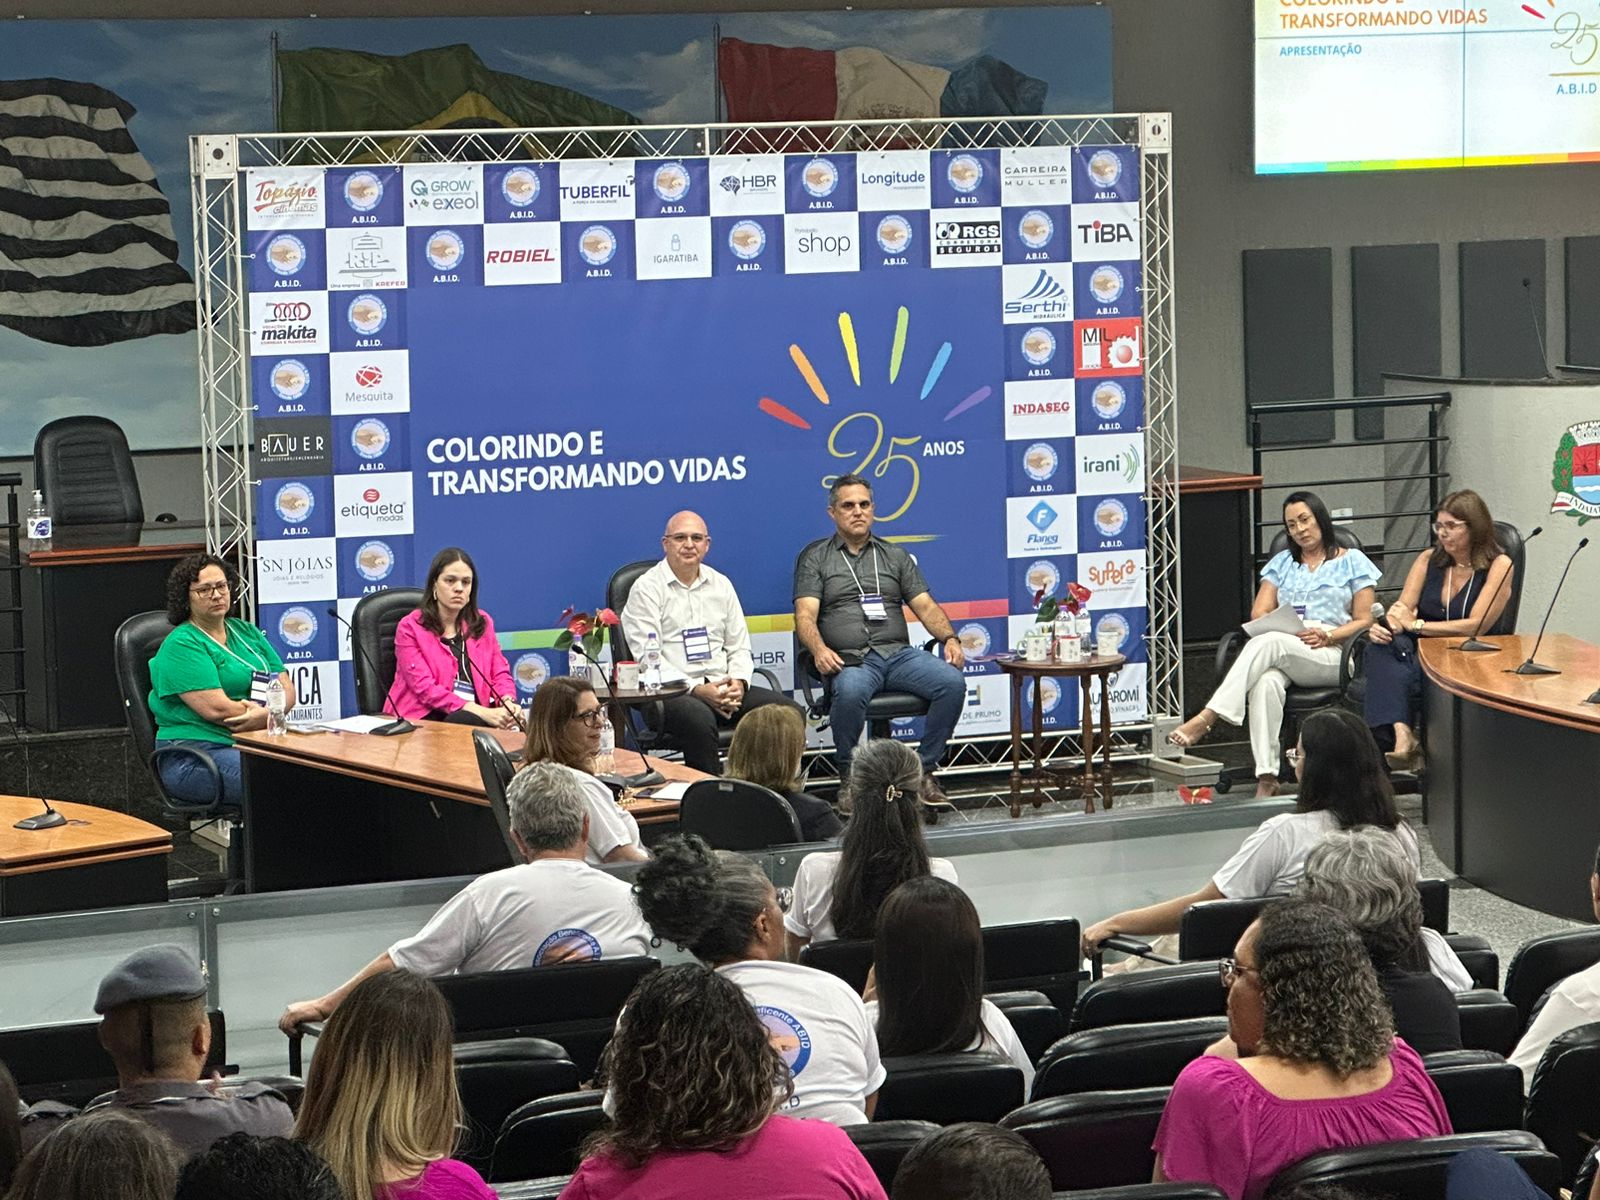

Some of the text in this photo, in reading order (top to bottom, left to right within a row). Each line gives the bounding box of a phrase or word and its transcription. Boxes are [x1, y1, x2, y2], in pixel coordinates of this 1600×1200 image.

[1280, 9, 1488, 29] TRANSFORMANDO VIDAS
[1550, 12, 1599, 65] 25
[1280, 43, 1362, 57] APRESENTAÇÃO
[1005, 166, 1067, 174] CARREIRA
[431, 180, 472, 192] GROW
[742, 175, 776, 187] HBR
[862, 171, 925, 186] Longitude
[256, 180, 318, 206] Topázio
[560, 185, 631, 199] TUBERFIL
[433, 191, 478, 210] exeol
[963, 226, 999, 238] RGS
[798, 233, 850, 256] shop
[940, 245, 998, 254] SEGUROS
[486, 249, 555, 263] ROBIEL
[654, 254, 698, 264] IGARATIBA
[1004, 300, 1066, 314] Serthi
[262, 325, 317, 340] makita
[346, 392, 393, 402] Mesquita
[1013, 402, 1070, 414] INDASEG
[427, 431, 603, 463] COLORINDO E
[923, 440, 965, 456] ANOS
[822, 412, 921, 522] 25
[1084, 454, 1120, 473] irani
[428, 456, 746, 496] TRANSFORMANDO VIDAS
[341, 502, 403, 518] etiqueta
[263, 560, 282, 572] SN
[292, 666, 322, 705] CA
[286, 708, 322, 721] STAURANTES
[792, 1024, 810, 1048] ABID
